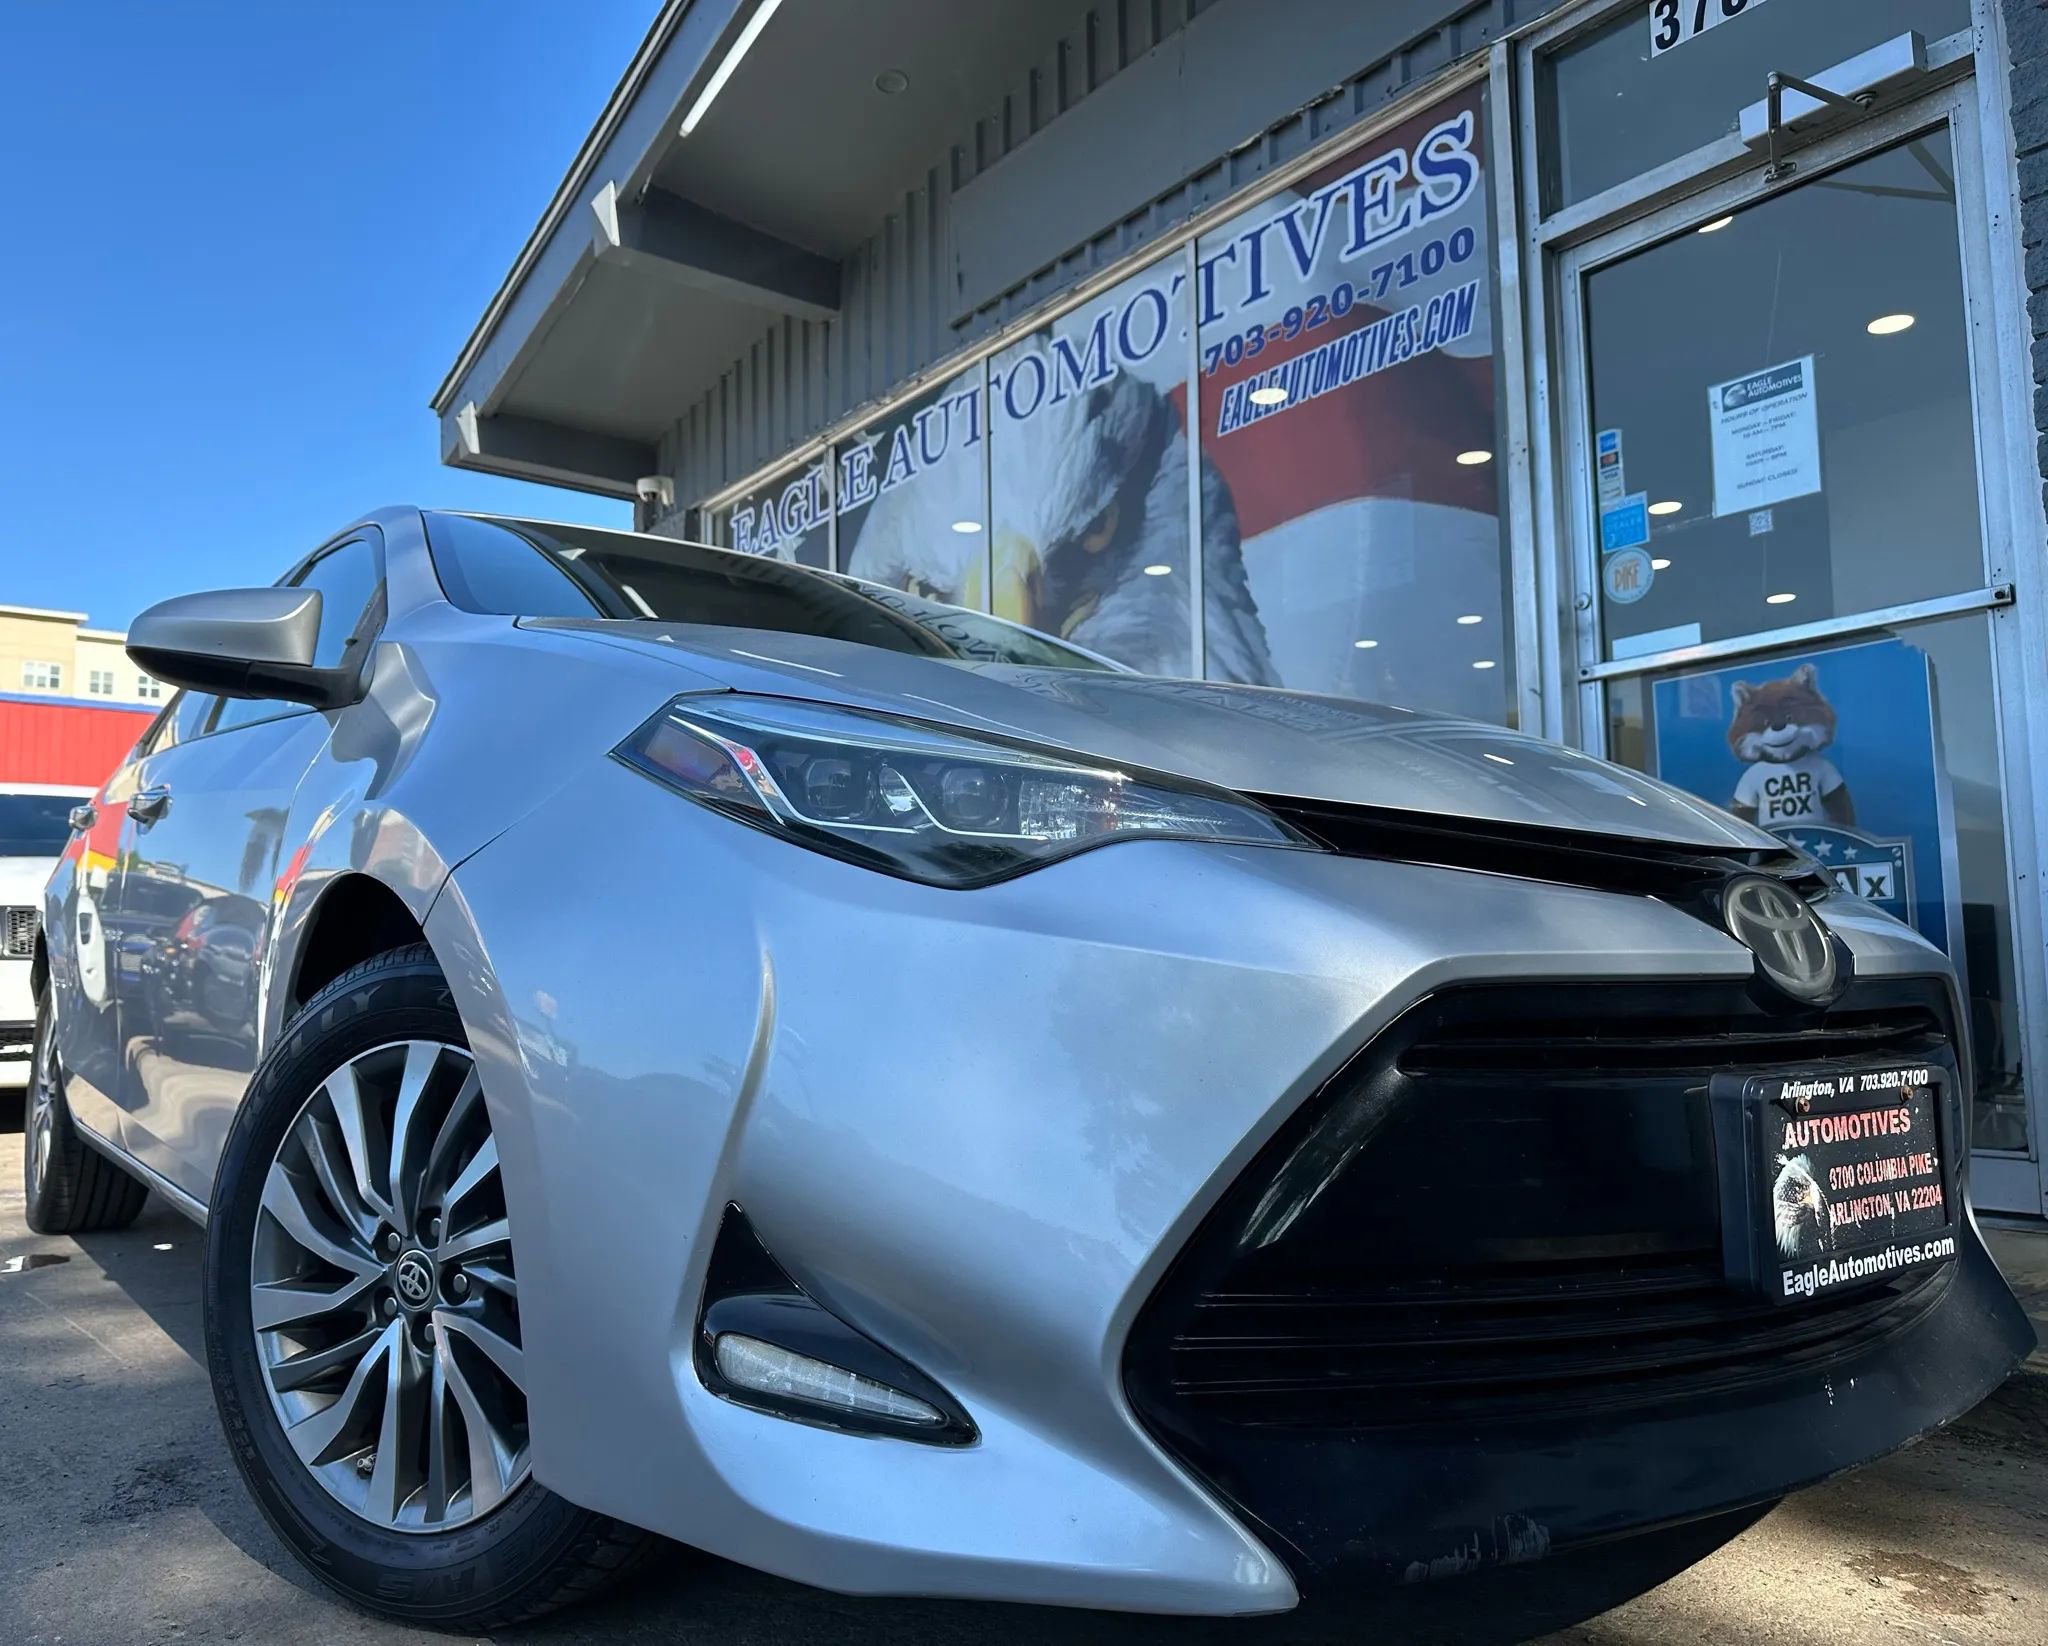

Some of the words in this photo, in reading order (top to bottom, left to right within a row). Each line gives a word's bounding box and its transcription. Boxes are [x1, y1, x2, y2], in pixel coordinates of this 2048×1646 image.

[1205, 227, 1475, 377] 703-920-7100
[731, 443, 876, 555] EAGLE
[881, 111, 1478, 494] AUTOMOTIVES
[1218, 280, 1479, 437] EAGLEAUTOMOTIVES.COM
[1747, 375, 1773, 391] EAGLE
[1748, 374, 1802, 398] AUTOMOTIVES
[1721, 410, 1748, 424] HOURS
[1761, 392, 1807, 412] OPERATION
[1764, 772, 1812, 798] CAR
[1768, 794, 1813, 819] FOX
[1780, 1081, 1835, 1099] Arlington,
[1838, 1077, 1854, 1093] VA
[1860, 1069, 1928, 1092] 703.920.7100
[1782, 1108, 1911, 1149] AUTOMOTIVES
[1829, 1165, 1854, 1190] 3700
[1857, 1157, 1909, 1185] COLUMBIA
[1909, 1153, 1933, 1176] PIKE
[1894, 1190, 1911, 1213] VA
[1911, 1184, 1943, 1209] 22204
[1782, 1236, 1955, 1296] EagleAutomotives.com
